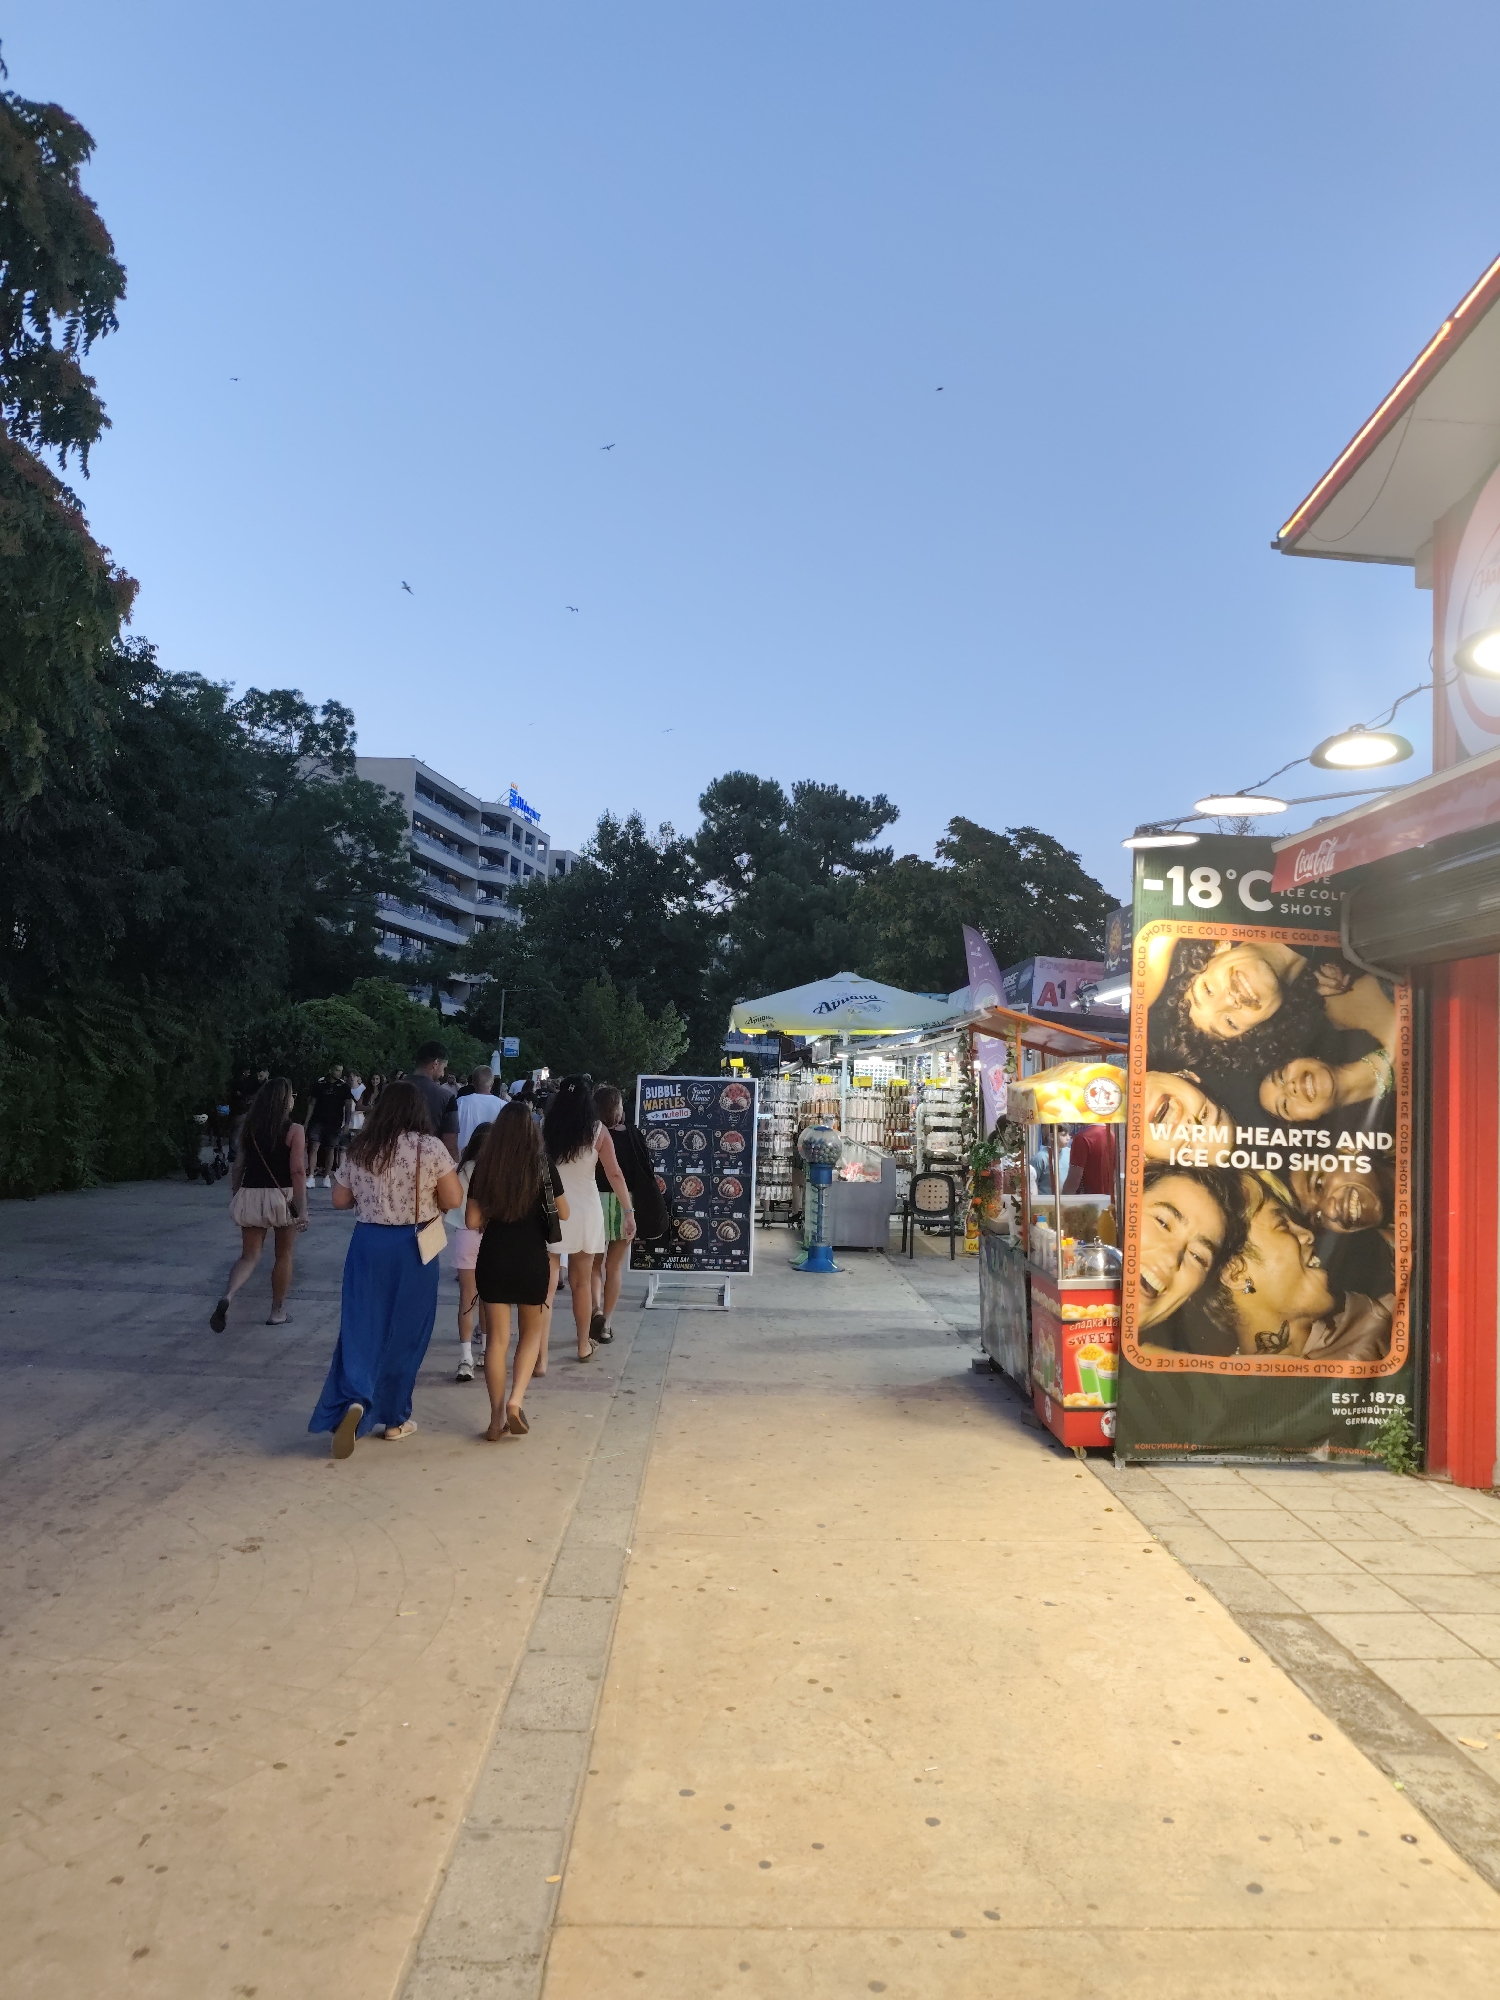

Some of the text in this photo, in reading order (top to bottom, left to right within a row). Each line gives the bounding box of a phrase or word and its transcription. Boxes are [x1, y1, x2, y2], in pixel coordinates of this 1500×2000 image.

[1280, 904, 1332, 916] SHOTS
[1142, 924, 1171, 942] SHOTS
[1177, 925, 1193, 934] ICE
[1199, 927, 1227, 936] COLD
[1232, 929, 1266, 938] SHOTS
[1271, 931, 1287, 940] ICE
[1292, 932, 1319, 942] COLD
[1036, 980, 1067, 1007] A1
[1400, 1004, 1409, 1021] ICE
[1400, 1026, 1409, 1056] COLD
[1401, 1062, 1409, 1096] SHOTS
[645, 1084, 681, 1099] BUBBLE
[691, 1093, 711, 1101] House
[692, 1087, 710, 1095] Sweet
[643, 1097, 686, 1111] WAFFLES
[661, 1110, 689, 1119] nutella
[1125, 946, 1146, 1339] SHOTS ICE COLD SHOTS ICE COLD SHOTS ICE COLD SHOTS ICE COLD
[1149, 1123, 1393, 1151] WARM HEARTS AND
[1400, 1124, 1408, 1154] COLD
[1169, 1147, 1372, 1174] ICE COLD SHOTS
[1399, 1160, 1408, 1195] SHOTS
[1399, 1200, 1407, 1217] ICE
[1400, 1223, 1408, 1253] COLD
[1400, 1258, 1408, 1293] SHOTS
[1397, 1299, 1405, 1316] ICE
[1068, 1332, 1115, 1345] SWEET
[1396, 1321, 1404, 1352] COLD
[1126, 1344, 1152, 1367] COLD
[1157, 1358, 1174, 1368] ICE
[1178, 1359, 1214, 1369] SHOTS
[1220, 1361, 1251, 1371] COLD
[1255, 1363, 1272, 1373] ICE
[1276, 1364, 1309, 1373] SHOTS
[1314, 1364, 1343, 1374] COLD
[1349, 1365, 1366, 1374] ICE
[1331, 1391, 1406, 1405] EST. 1878
